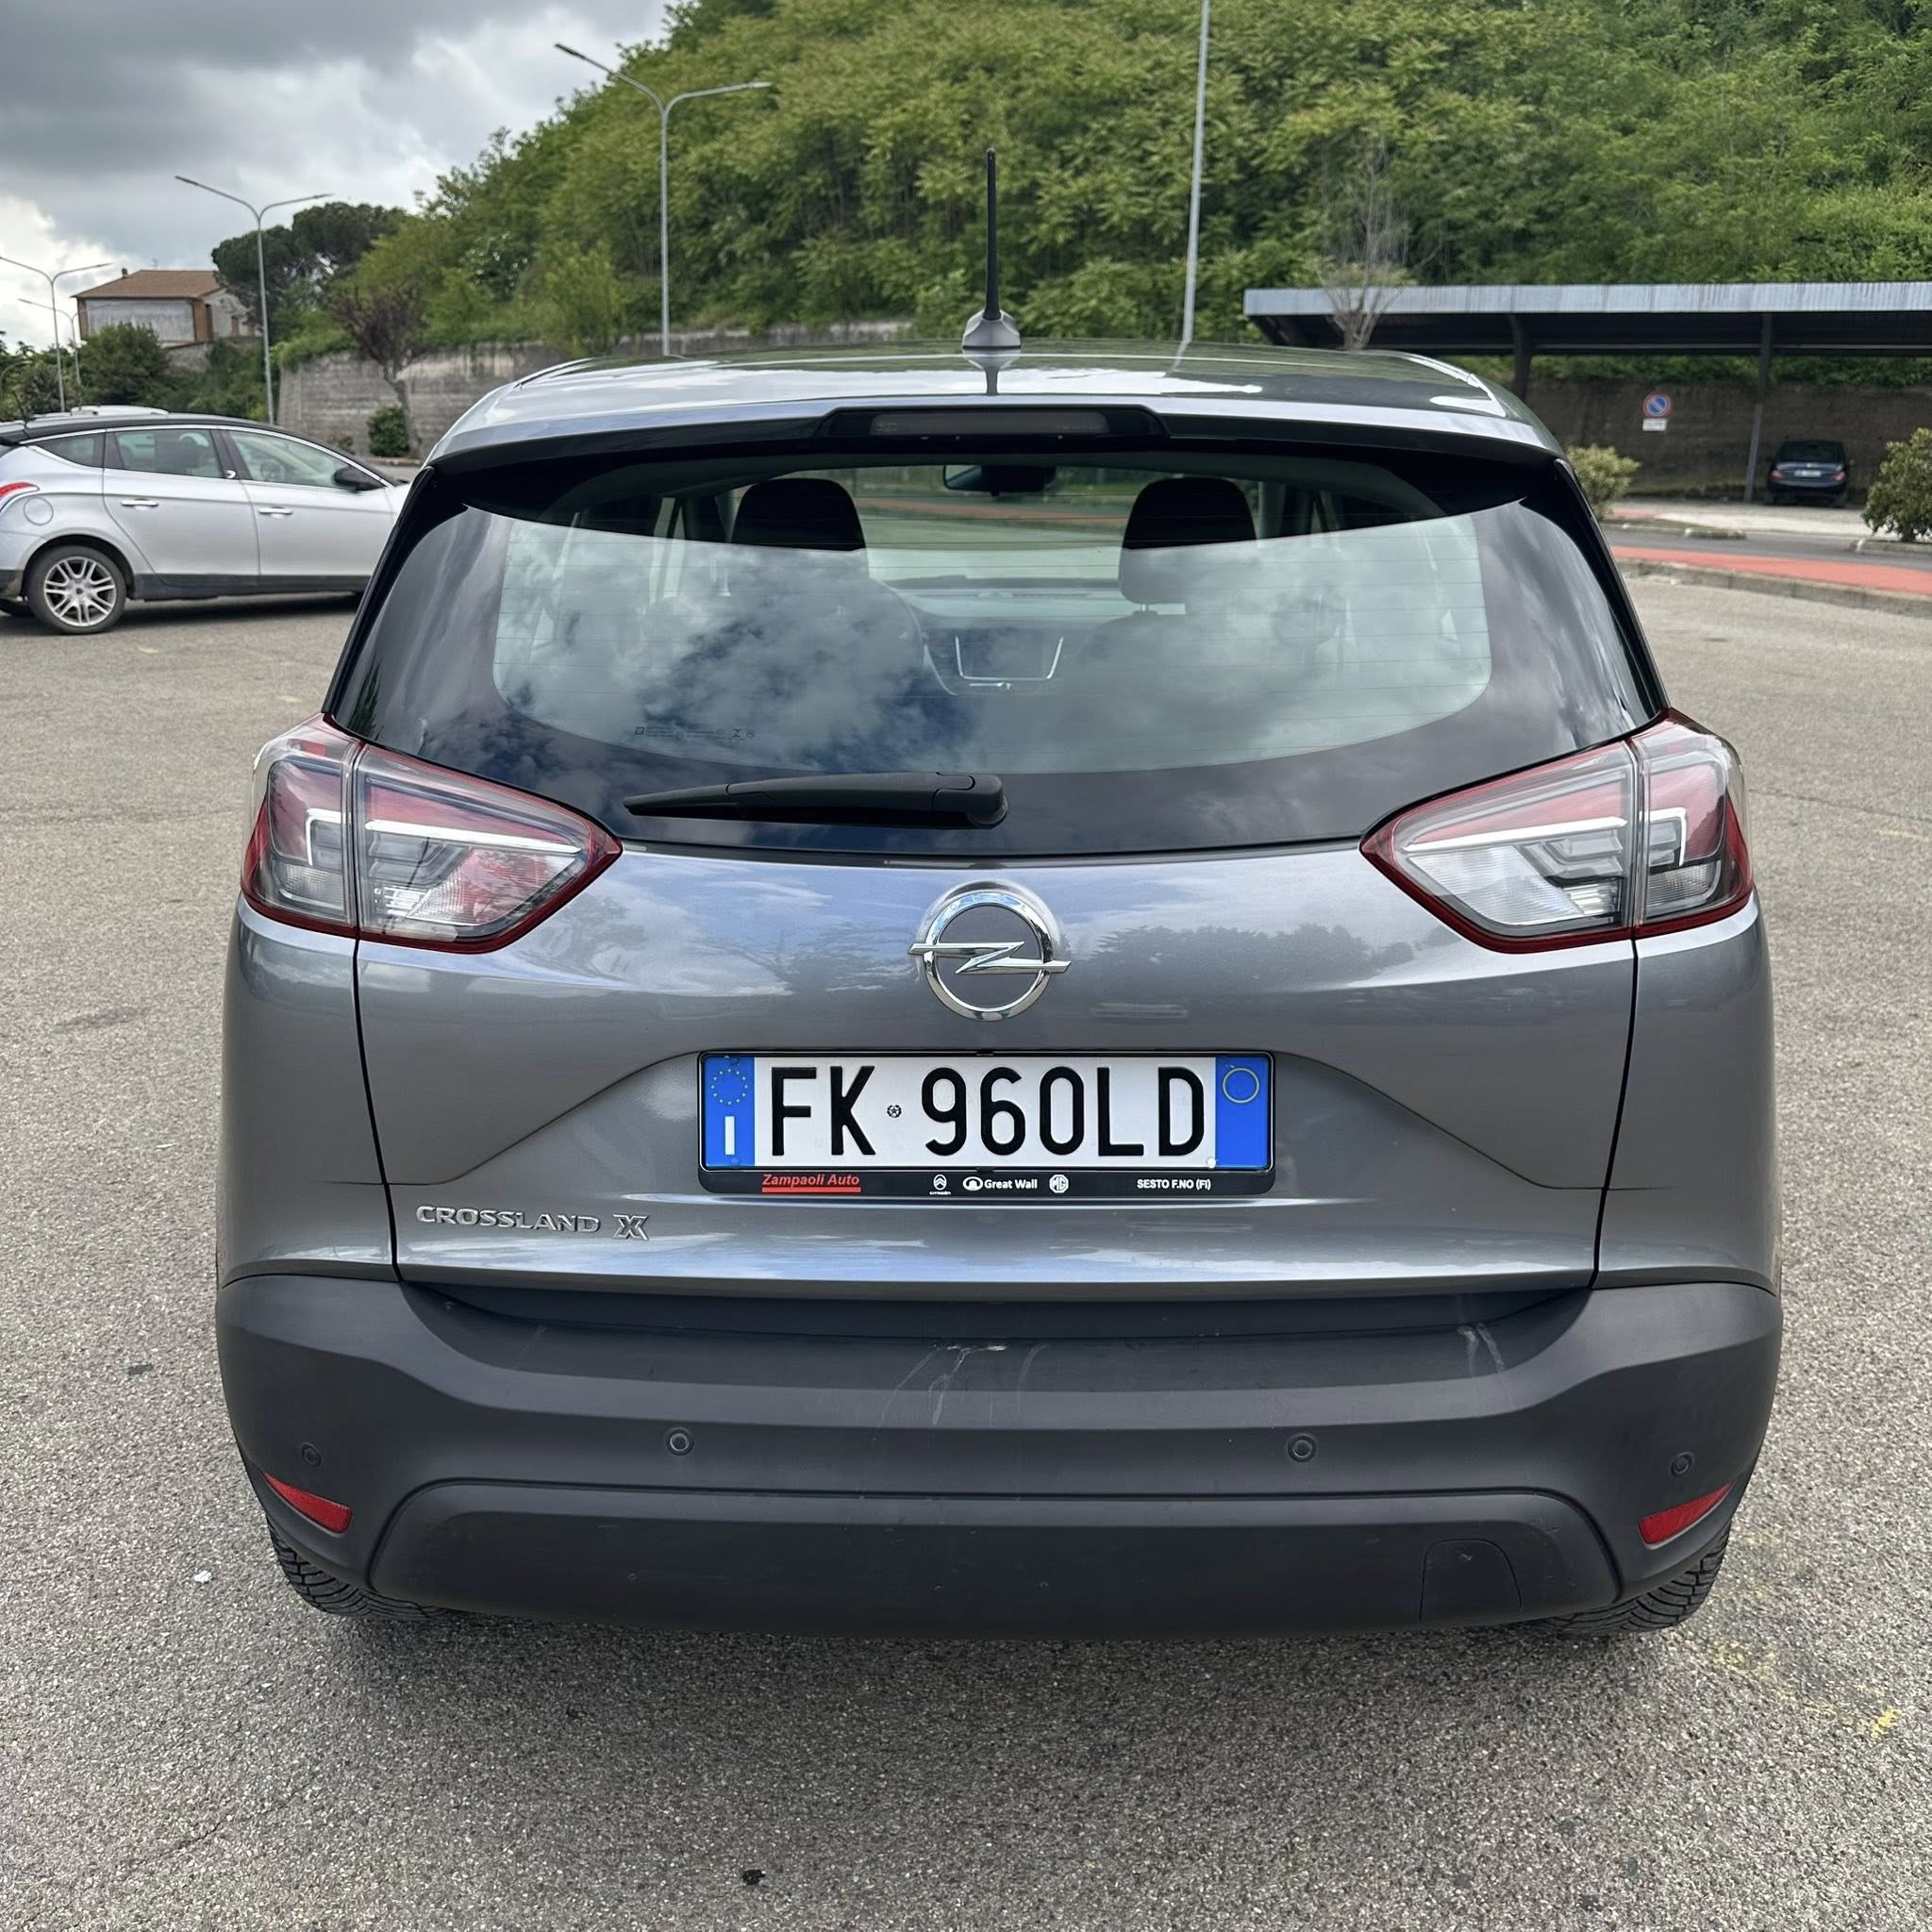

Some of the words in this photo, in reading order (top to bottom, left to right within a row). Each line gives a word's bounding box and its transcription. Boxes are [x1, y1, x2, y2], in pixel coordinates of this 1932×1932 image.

[771, 1065, 876, 1157] FK
[921, 1066, 1205, 1157] 960LD
[761, 1174, 825, 1189] Zampaoli
[826, 1174, 860, 1186] Auto
[984, 1179, 1013, 1190] Great
[1014, 1179, 1039, 1190] Wall
[1050, 1175, 1068, 1192] MG
[1137, 1179, 1170, 1189] SESTO
[1172, 1179, 1194, 1190] F.NO
[1195, 1178, 1211, 1191] (FI)
[415, 1205, 601, 1233] CROSSLAND
[613, 1213, 650, 1241] X
